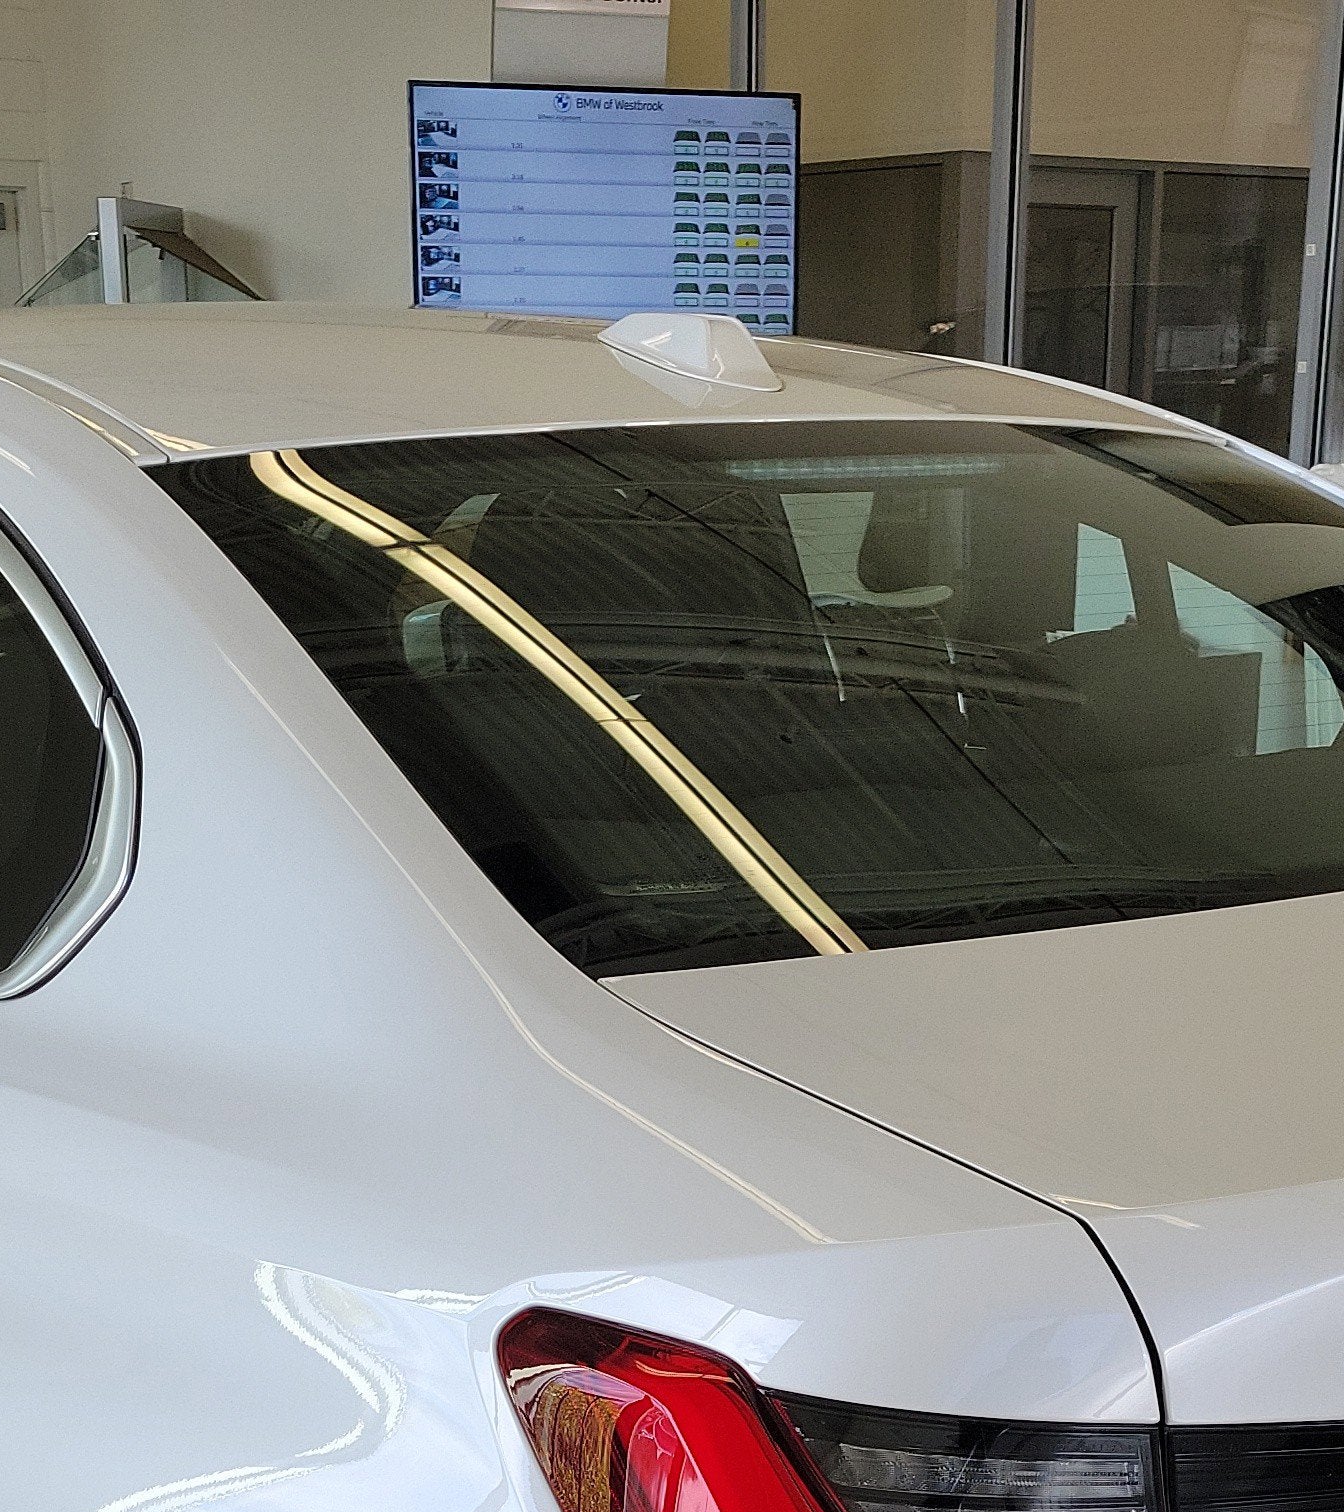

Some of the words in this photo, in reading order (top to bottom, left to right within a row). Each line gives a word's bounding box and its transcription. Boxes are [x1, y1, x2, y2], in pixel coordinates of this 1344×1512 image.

[576, 97, 600, 110] BMW
[603, 99, 613, 110] of
[614, 99, 664, 112] Westbrook
